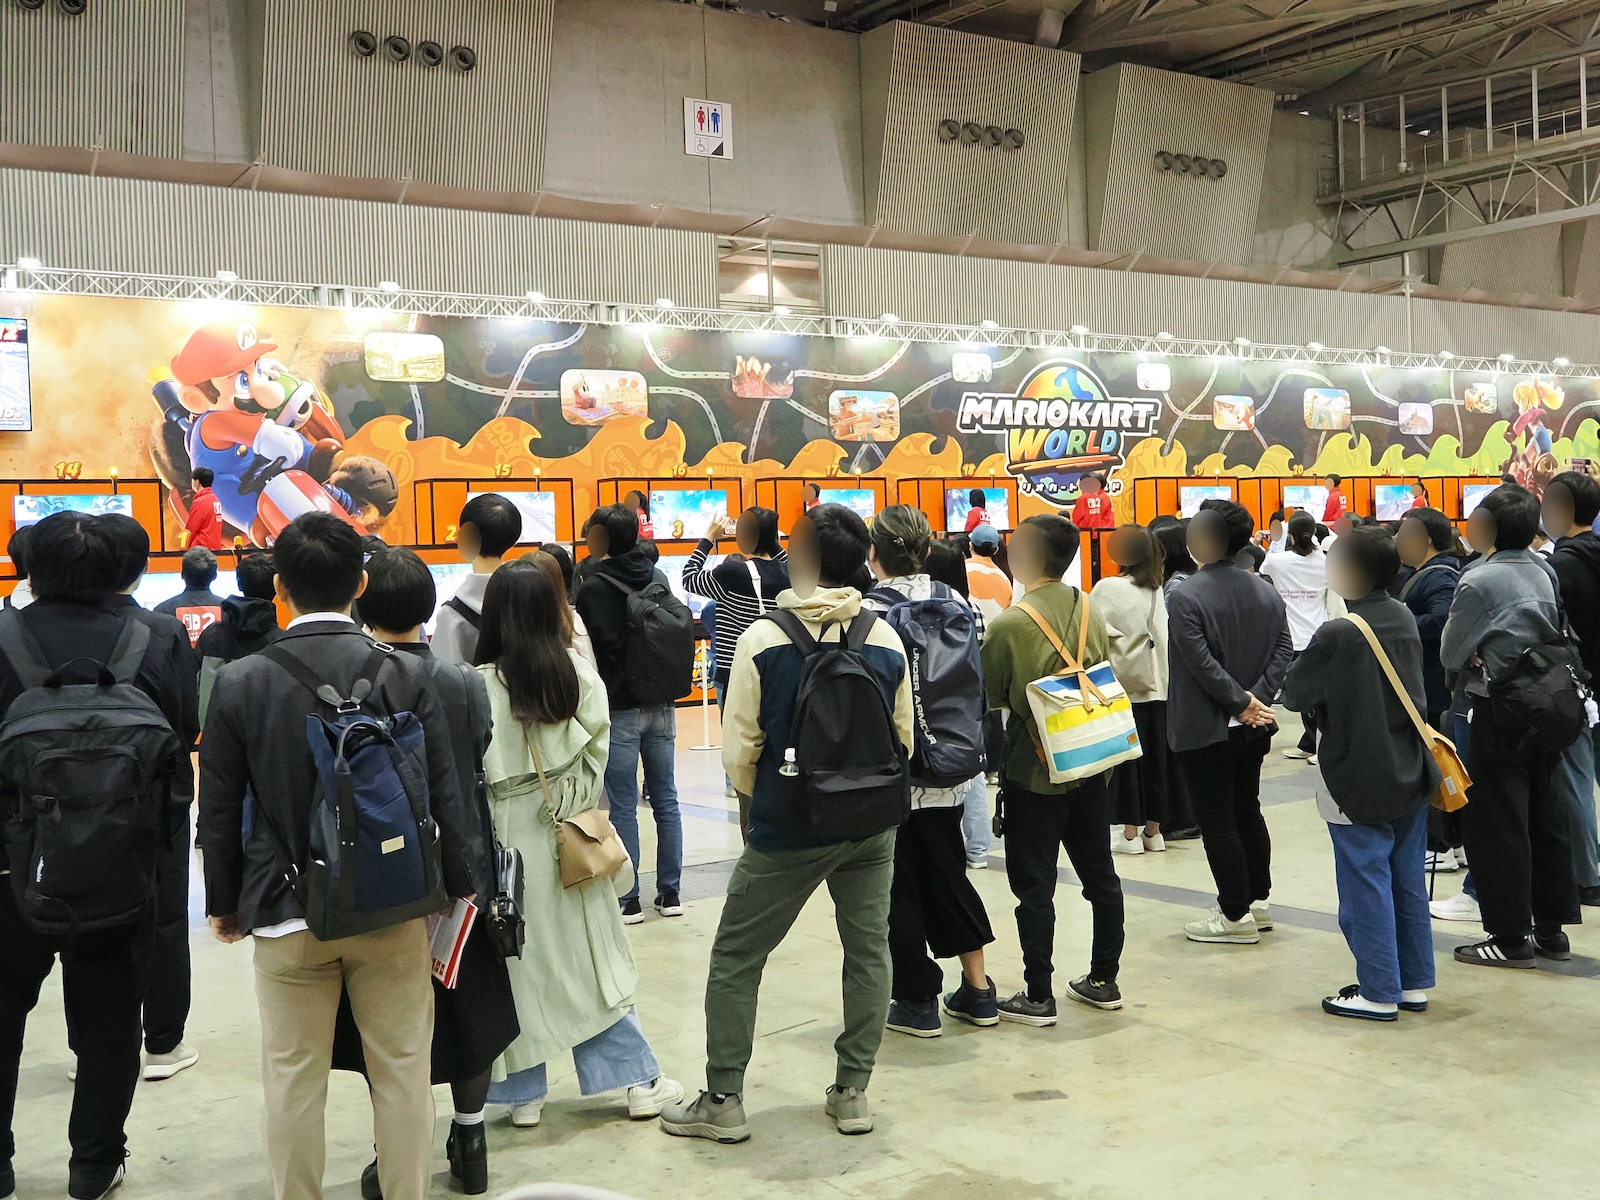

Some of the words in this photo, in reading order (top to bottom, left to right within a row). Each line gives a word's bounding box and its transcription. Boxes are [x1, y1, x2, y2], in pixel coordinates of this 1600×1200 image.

[1009, 428, 1119, 462] WORLD
[55, 462, 82, 479] 14
[494, 463, 512, 477] 15
[672, 463, 687, 477] 16
[825, 464, 839, 477] 17
[962, 463, 976, 476] 18
[1193, 464, 1204, 475] 19
[1293, 464, 1304, 475] 20
[1469, 466, 1478, 476] 22
[1022, 482, 1078, 494] リオカート
[445, 525, 457, 541] 2
[672, 520, 684, 538] 3
[177, 531, 189, 548] 1
[912, 647, 920, 692] UNDER
[914, 694, 938, 746] ARMOUR
